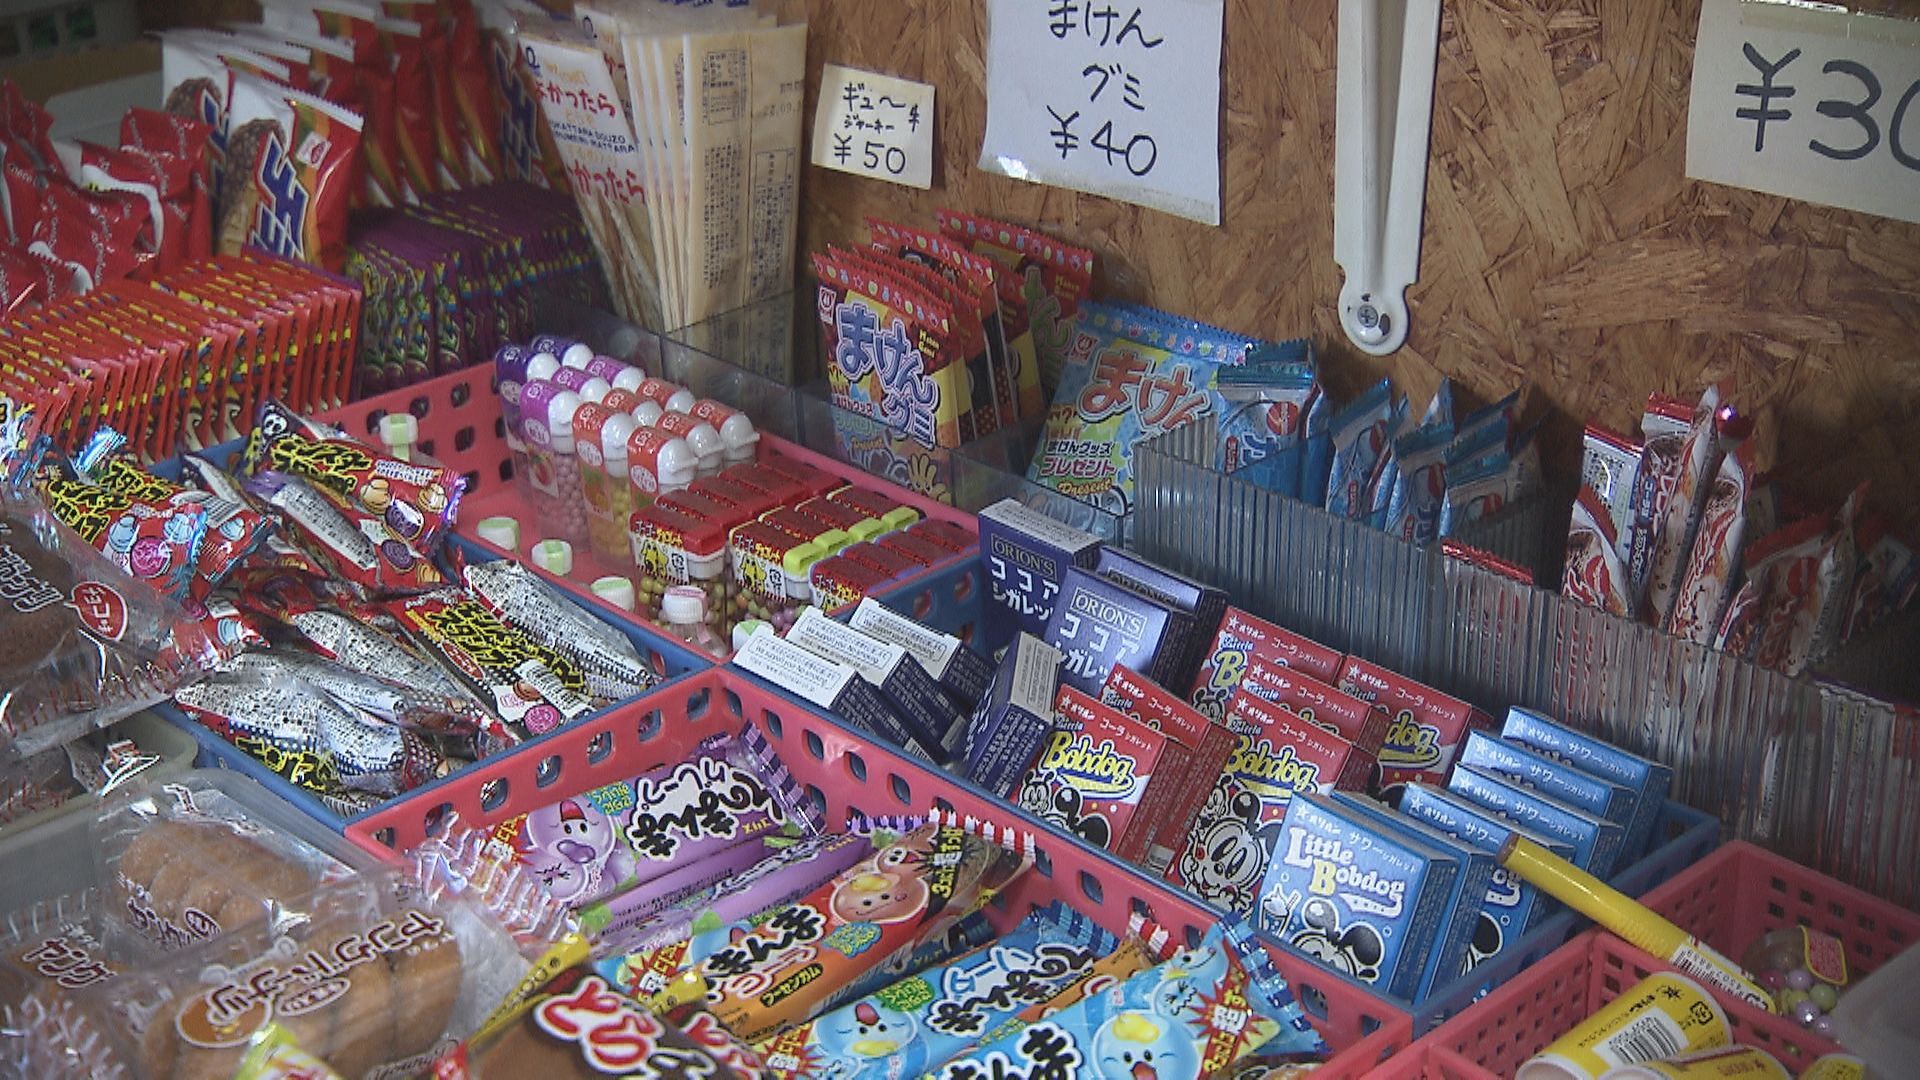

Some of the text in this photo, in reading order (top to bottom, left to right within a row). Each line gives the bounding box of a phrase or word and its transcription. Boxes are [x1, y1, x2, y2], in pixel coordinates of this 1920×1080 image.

[1048, 0, 1164, 48] まけん
[1082, 63, 1146, 110] グミ
[843, 114, 895, 134] ジャーキー
[1046, 104, 1158, 176] ¥40
[833, 132, 906, 174] ¥50
[836, 302, 940, 408] まけん
[1040, 454, 1118, 478] プレゼント
[993, 538, 1056, 577] ORION'S
[990, 555, 1060, 601] ココア
[1074, 594, 1147, 636] ORION'S
[1059, 611, 1141, 662] ココア
[1271, 636, 1298, 655] コーラ
[1148, 697, 1172, 717] コーラ
[1296, 686, 1326, 705] コーラ
[1395, 687, 1425, 706] コーラ
[1099, 717, 1126, 738] コーラ
[1279, 721, 1308, 742] コーラ
[1047, 731, 1135, 785] Bobdog
[1226, 735, 1316, 791] Bobdog
[1568, 740, 1603, 763] サワー
[639, 759, 728, 811] グレープ
[1529, 763, 1565, 786] サワー
[1514, 800, 1551, 824] サワー
[1283, 826, 1354, 869] Little
[1349, 831, 1384, 853] サワー
[1464, 820, 1500, 844] サワー
[1308, 857, 1407, 903] Bobdog
